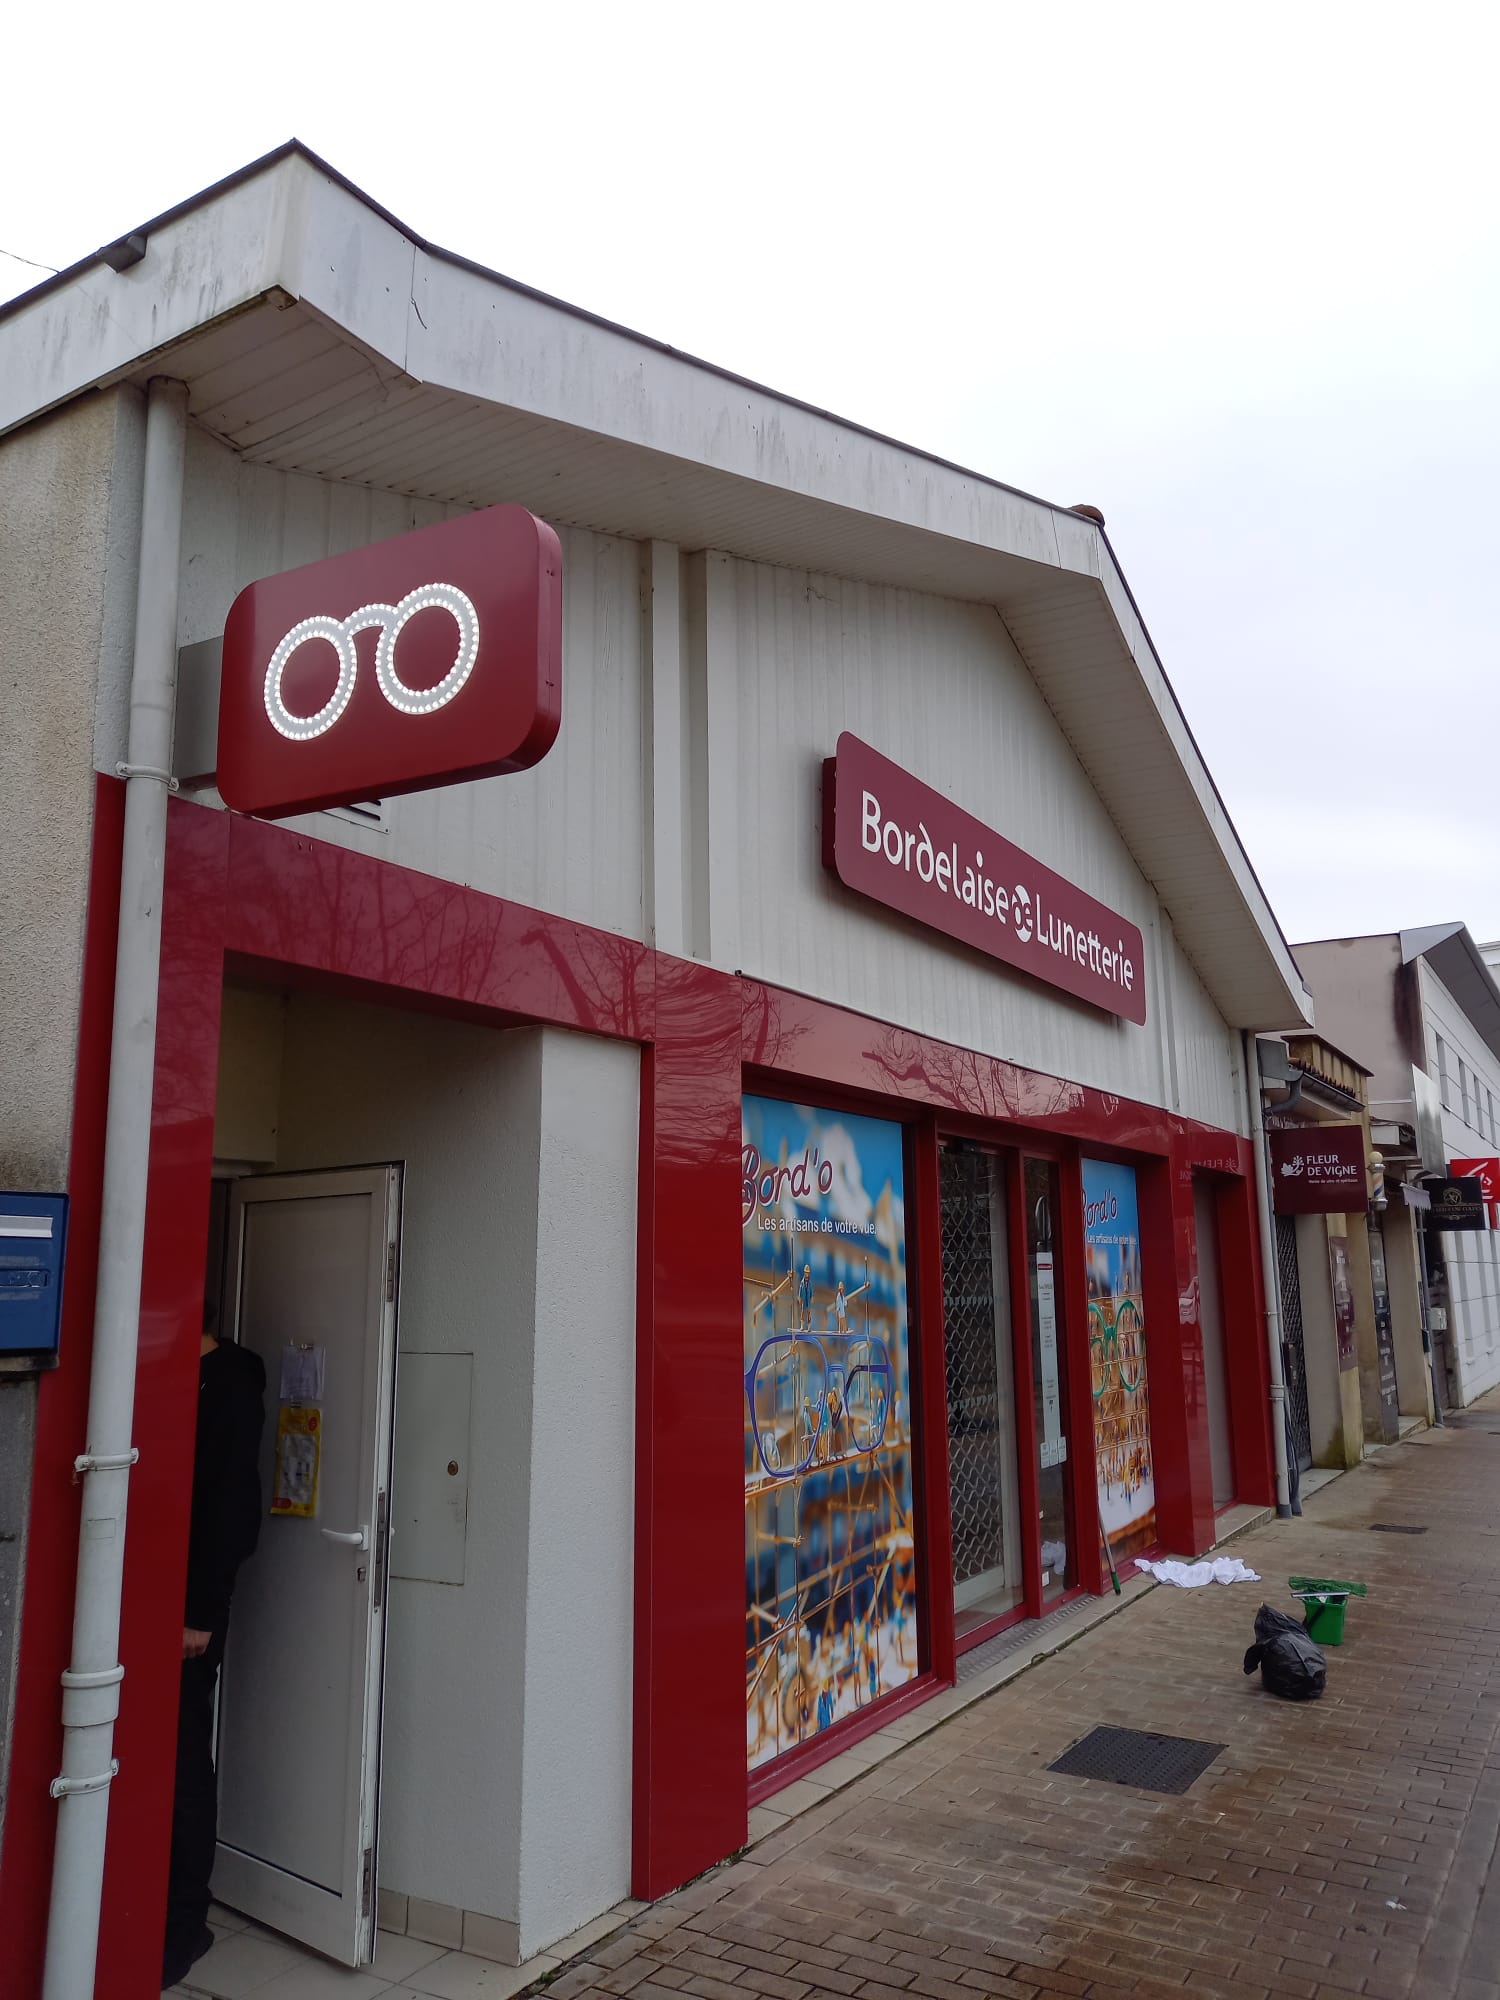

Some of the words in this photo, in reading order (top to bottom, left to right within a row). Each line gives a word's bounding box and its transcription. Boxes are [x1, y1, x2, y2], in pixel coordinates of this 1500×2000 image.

[862, 790, 1009, 924] Bordelaise
[1036, 894, 1134, 991] Lunetterie
[1306, 1154, 1339, 1165] FLEUR
[1307, 1166, 1322, 1176] DE
[1323, 1165, 1357, 1178] VIGNE
[757, 1213, 777, 1231] Les
[779, 1217, 819, 1233] artisans
[821, 1216, 833, 1233] de
[834, 1219, 858, 1234] votre
